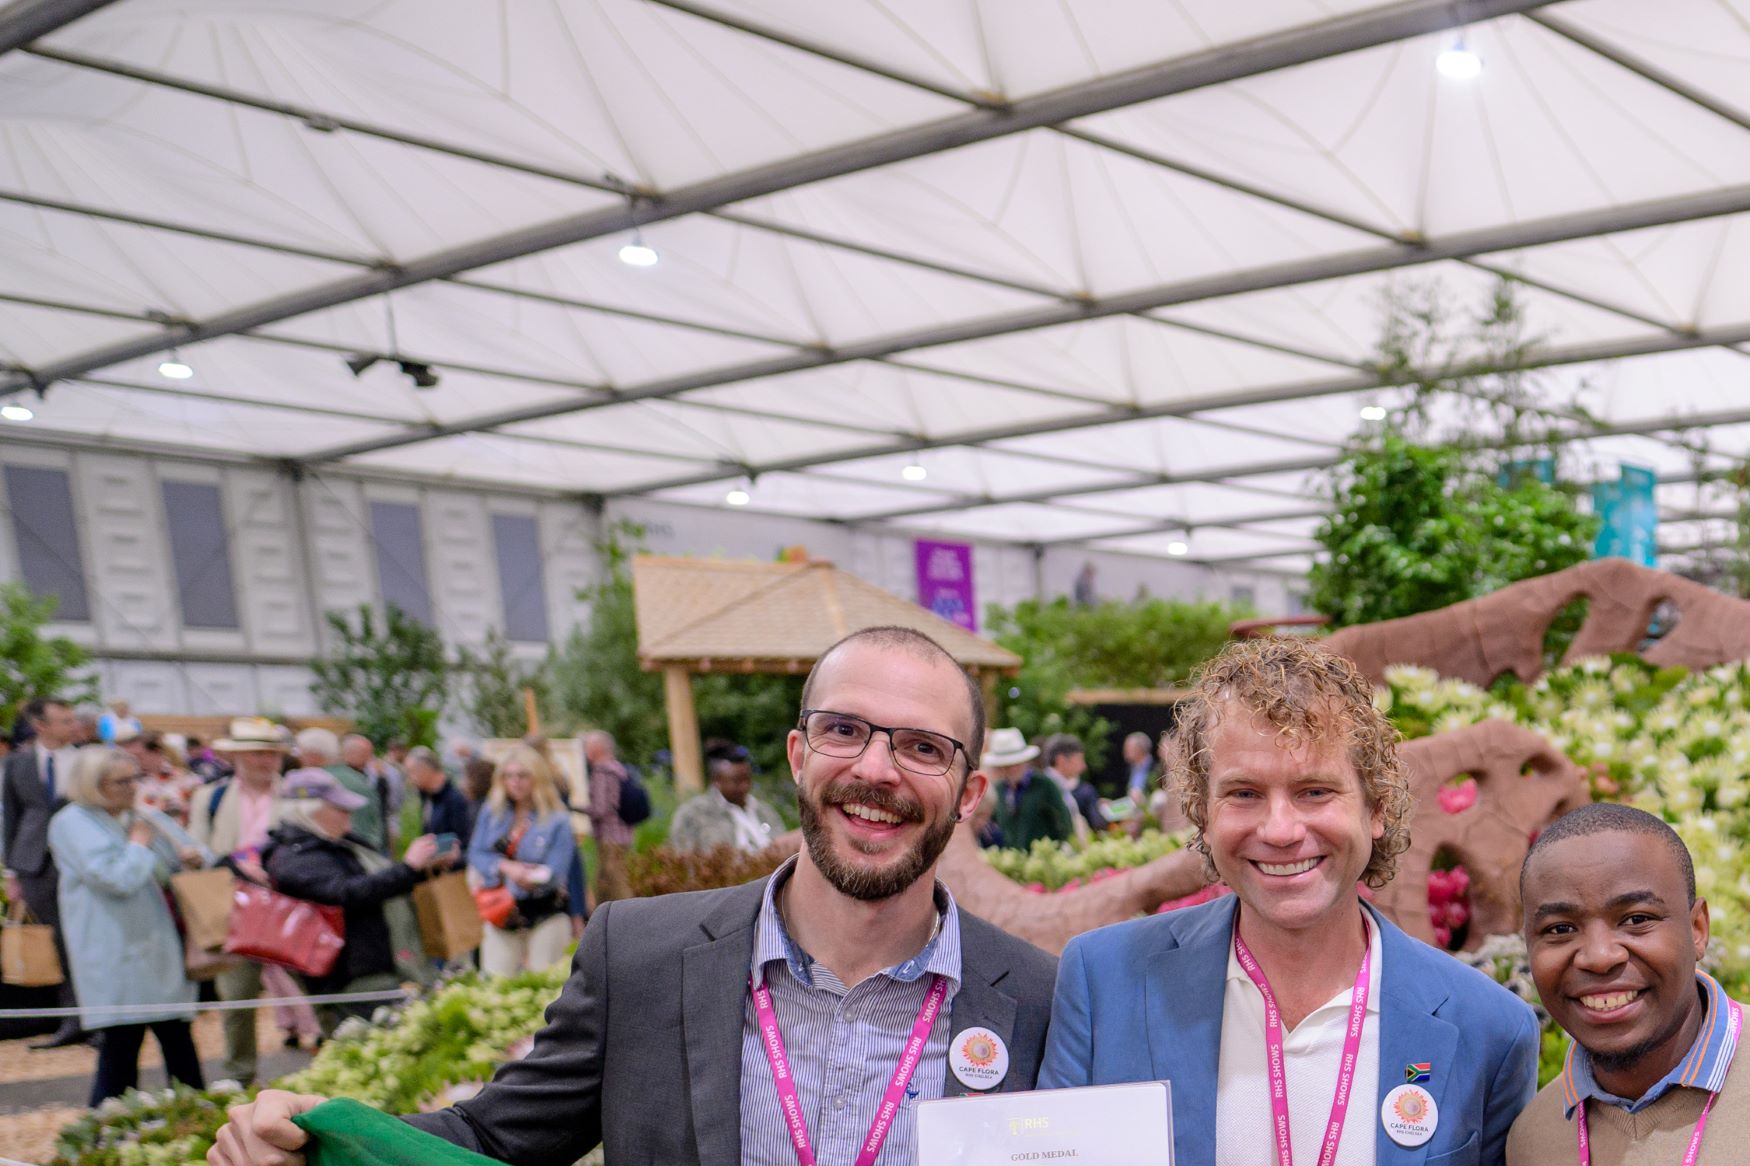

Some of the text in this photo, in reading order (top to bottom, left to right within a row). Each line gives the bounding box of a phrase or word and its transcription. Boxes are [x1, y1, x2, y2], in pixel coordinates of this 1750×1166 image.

[1242, 955, 1256, 971] RHS
[757, 990, 768, 1009] RHS
[923, 993, 940, 1022] SHOWS
[1351, 986, 1364, 1037] RHS SHOWS
[1269, 1010, 1277, 1027] RHS
[766, 1025, 787, 1078] RHS SHOWS
[895, 1037, 921, 1086] RHS SHOWS
[1271, 1044, 1283, 1098] RHS SHOWS
[1338, 1054, 1353, 1105] RHS SHOWS
[785, 1095, 806, 1148] RHS SHOWS
[867, 1102, 894, 1152] RHS SHOWS
[1024, 1117, 1049, 1128] RHS
[1278, 1115, 1288, 1147] SHOWS
[1329, 1122, 1339, 1140] RHS
[1011, 1149, 1079, 1161] GOLD MEDAL
[1686, 1131, 1700, 1163] SHOWS
